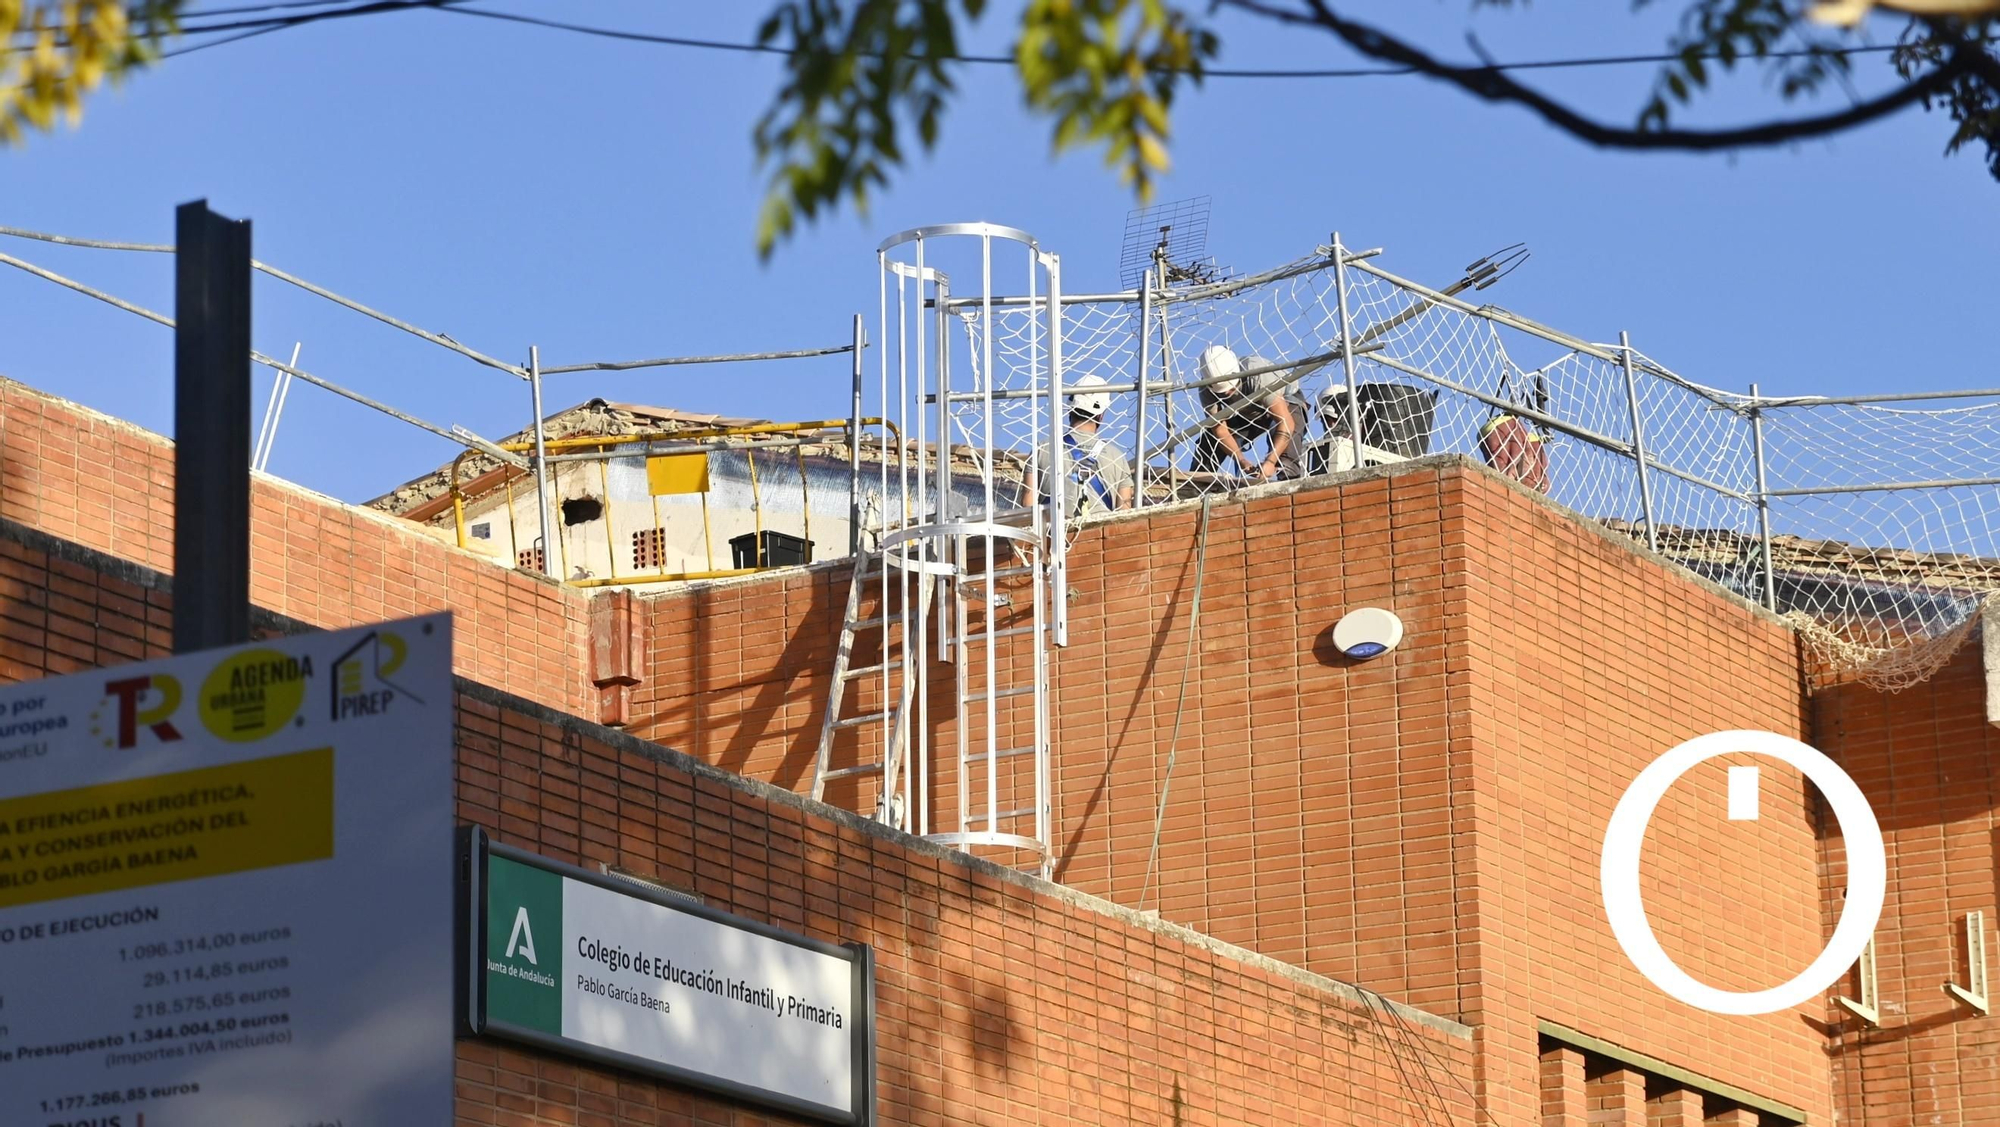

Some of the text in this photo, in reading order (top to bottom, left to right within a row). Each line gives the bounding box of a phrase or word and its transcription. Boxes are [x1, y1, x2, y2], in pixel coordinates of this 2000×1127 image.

[230, 654, 313, 689] AGENDA
[12, 696, 47, 716] por
[210, 688, 266, 710] URBANA
[341, 690, 394, 719] PIREP
[15, 806, 110, 834] EFIENCIA
[17, 843, 30, 860] Y
[35, 816, 204, 857] CONSERVACIÓN
[210, 810, 249, 829] DEL
[127, 845, 198, 869] BAENA
[20, 923, 45, 940] DE
[50, 907, 159, 936] EJECUCIÓN
[119, 926, 291, 963] 1.096.314,00 euros
[143, 955, 289, 988] 29.114,85 euros
[508, 964, 518, 977] de
[518, 967, 555, 987] Andalucía
[578, 936, 843, 1030] Colegio de Educación Infantil y Primaria
[133, 986, 291, 1019] 218.575,65 euros
[577, 974, 670, 1014] Pablo García Baena
[17, 1035, 124, 1059] Presupuesto
[129, 1018, 236, 1044] 1.344.004,50
[240, 1012, 290, 1028] euros
[105, 1029, 292, 1069] (Importes IVA incluido)
[40, 1081, 200, 1113] 1.177.266,85 euros
